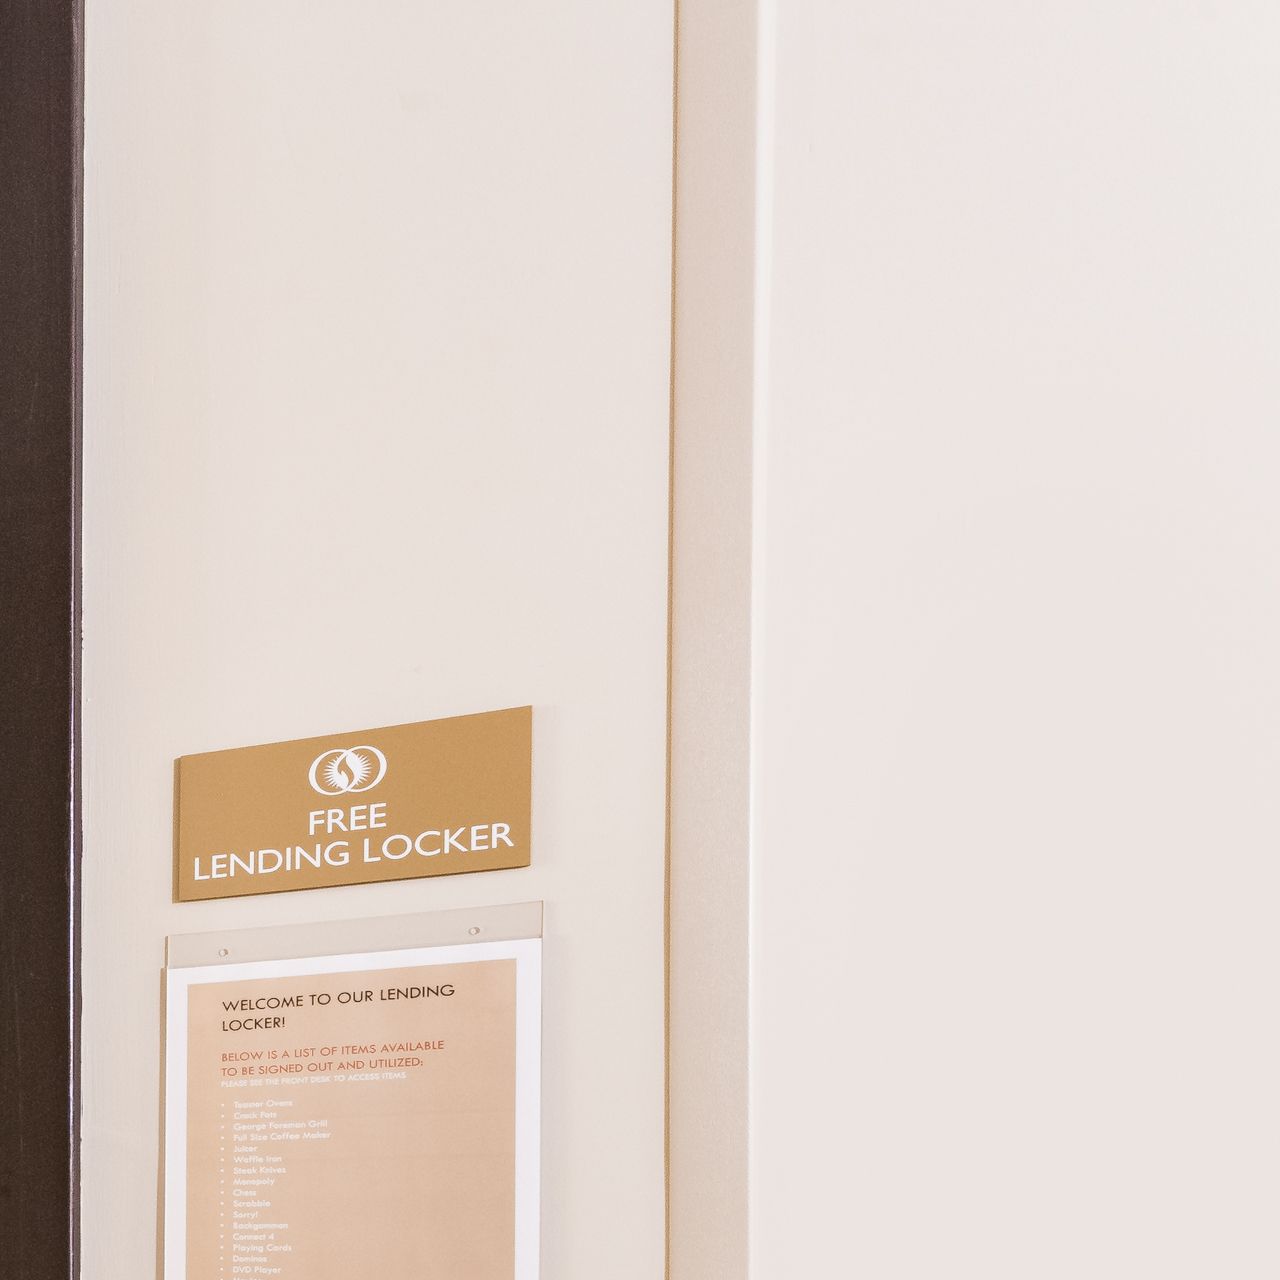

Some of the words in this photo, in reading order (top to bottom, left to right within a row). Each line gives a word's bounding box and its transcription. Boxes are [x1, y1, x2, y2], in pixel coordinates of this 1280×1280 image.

[308, 803, 387, 835] FREE
[194, 841, 350, 881] LENDING
[363, 823, 514, 863] LOCKER
[222, 995, 303, 1012] WELCOME
[309, 993, 332, 1007] TO
[338, 990, 373, 1004] OUR
[380, 984, 456, 1001] LENDING
[222, 1017, 286, 1032] LOCKER!
[222, 1051, 263, 1062] BELOW
[268, 1050, 278, 1059] IS
[282, 1050, 290, 1059] A
[294, 1048, 316, 1058] LIST
[320, 1046, 337, 1056] OF
[342, 1044, 377, 1055] ITEMS
[381, 1040, 445, 1053] AVAILABLE
[222, 1068, 238, 1076] TO
[241, 1066, 255, 1075] BE
[259, 1063, 303, 1075] SIGNED
[307, 1062, 333, 1072] OUT
[337, 1060, 365, 1071] AND
[369, 1057, 424, 1069] UTILIZED:
[335, 1074, 347, 1082] TO
[348, 1073, 381, 1081] ACCESS
[383, 1071, 407, 1080] ITEMS
